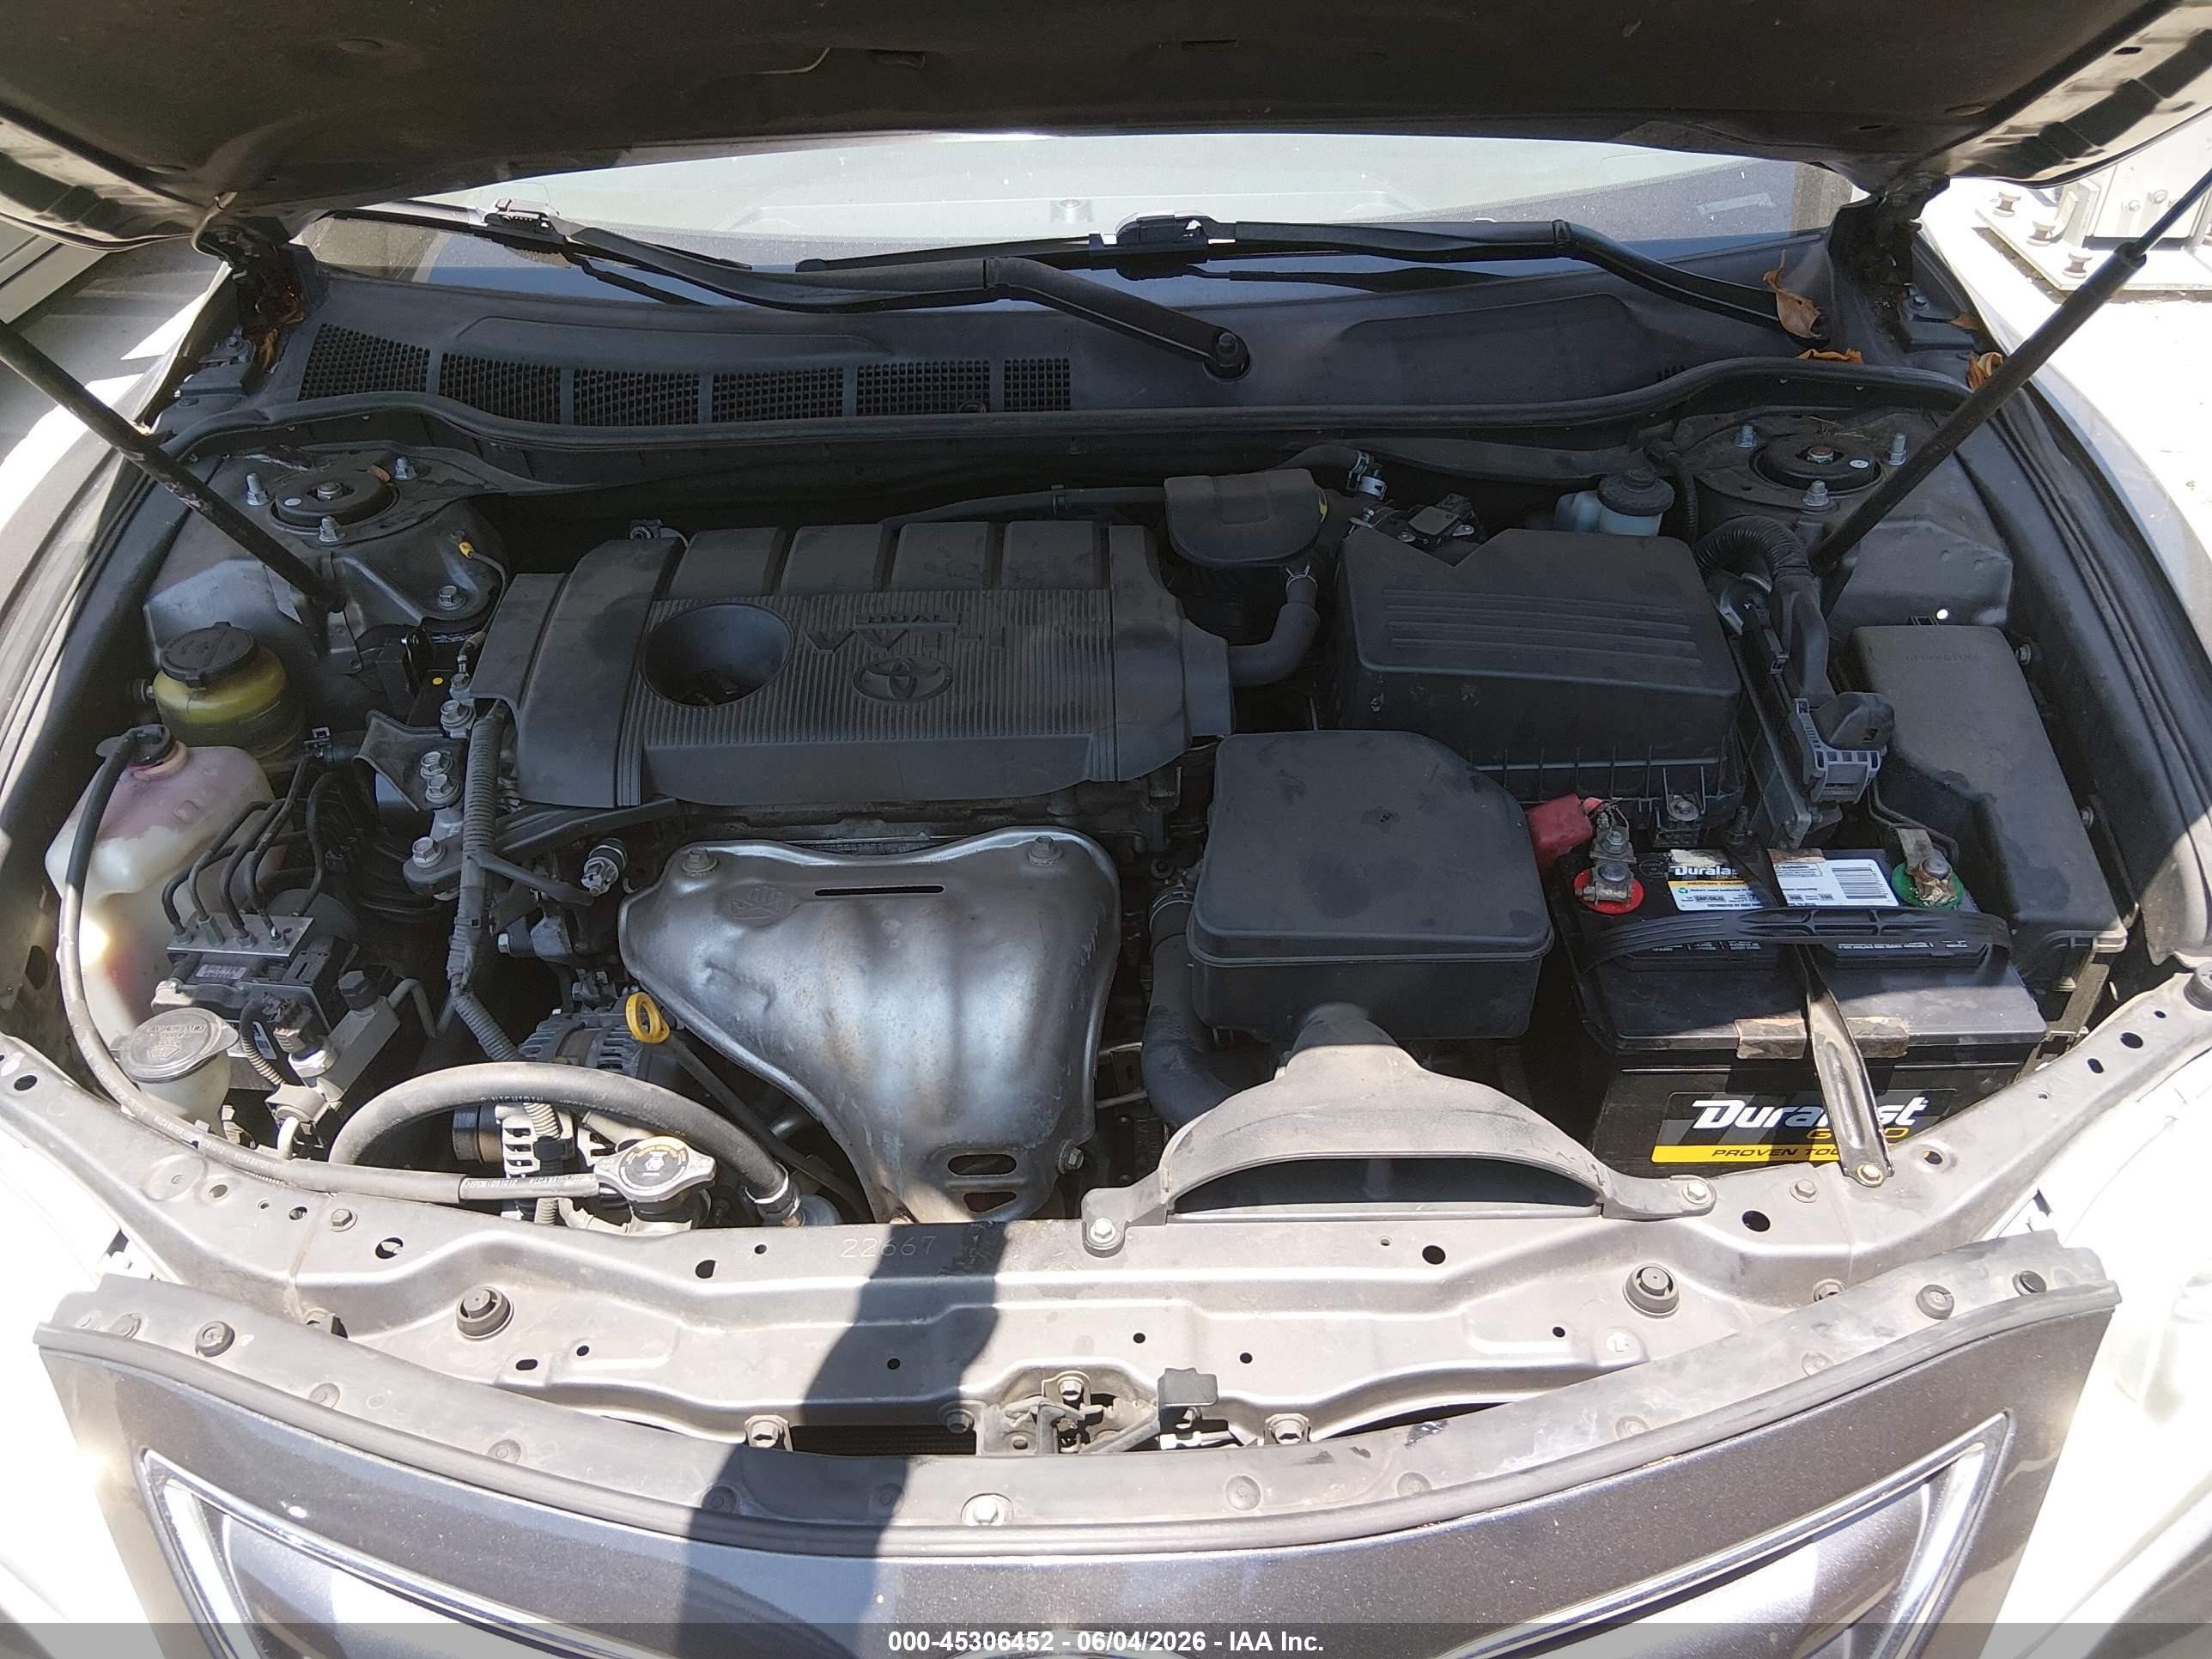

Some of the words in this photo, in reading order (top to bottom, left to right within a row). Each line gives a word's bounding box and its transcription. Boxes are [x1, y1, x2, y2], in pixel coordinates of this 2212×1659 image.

[1806, 1127, 1910, 1139] GD
[1711, 1148, 1799, 1157] PROVEN
[1804, 1147, 1840, 1156] TOU
[840, 1236, 938, 1259] 22667
